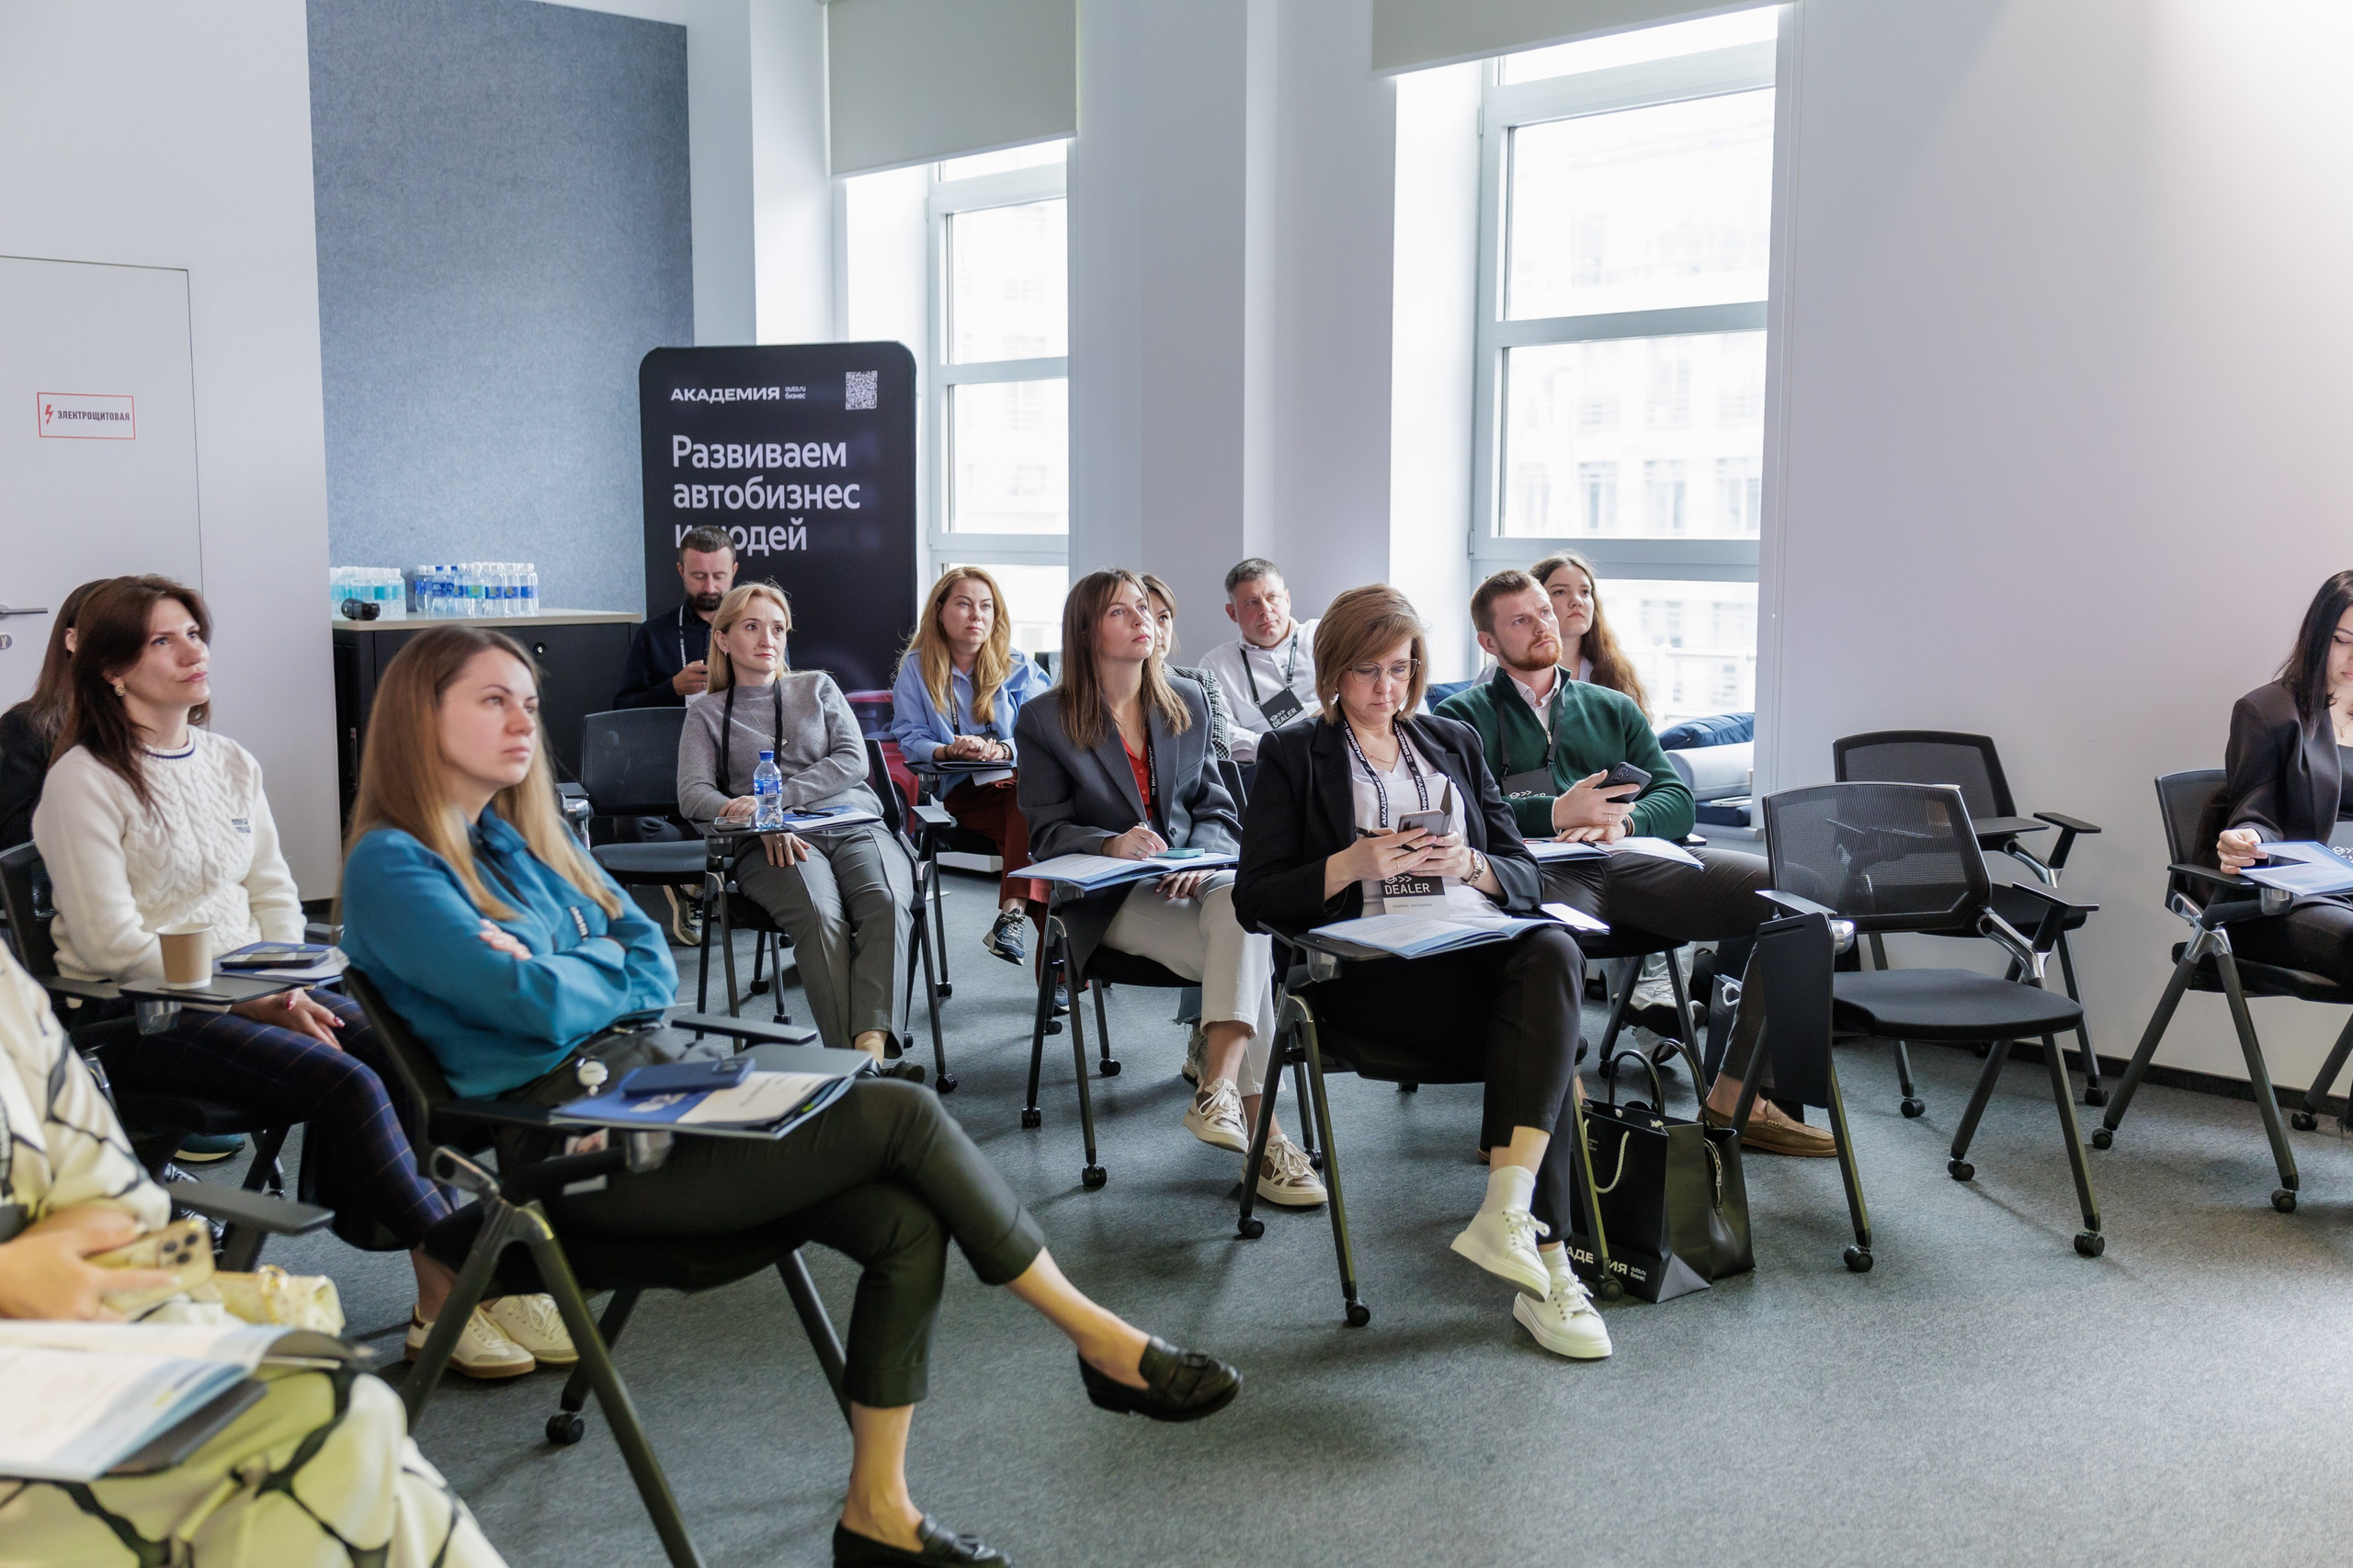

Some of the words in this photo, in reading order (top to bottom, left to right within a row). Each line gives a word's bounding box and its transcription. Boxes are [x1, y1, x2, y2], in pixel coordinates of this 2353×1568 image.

[671, 387, 780, 403] АКАДЕМИЯ
[57, 410, 130, 421] ЭЛЕКТРОЩИТОВАЯ
[673, 435, 847, 469] Развиваем
[673, 475, 860, 509] автобизнес
[1272, 708, 1297, 728] DEALER
[1376, 781, 1388, 826] АКАДЕМИЯ
[1415, 775, 1427, 811] АКАДЕМИ
[1384, 882, 1430, 895] DEALER
